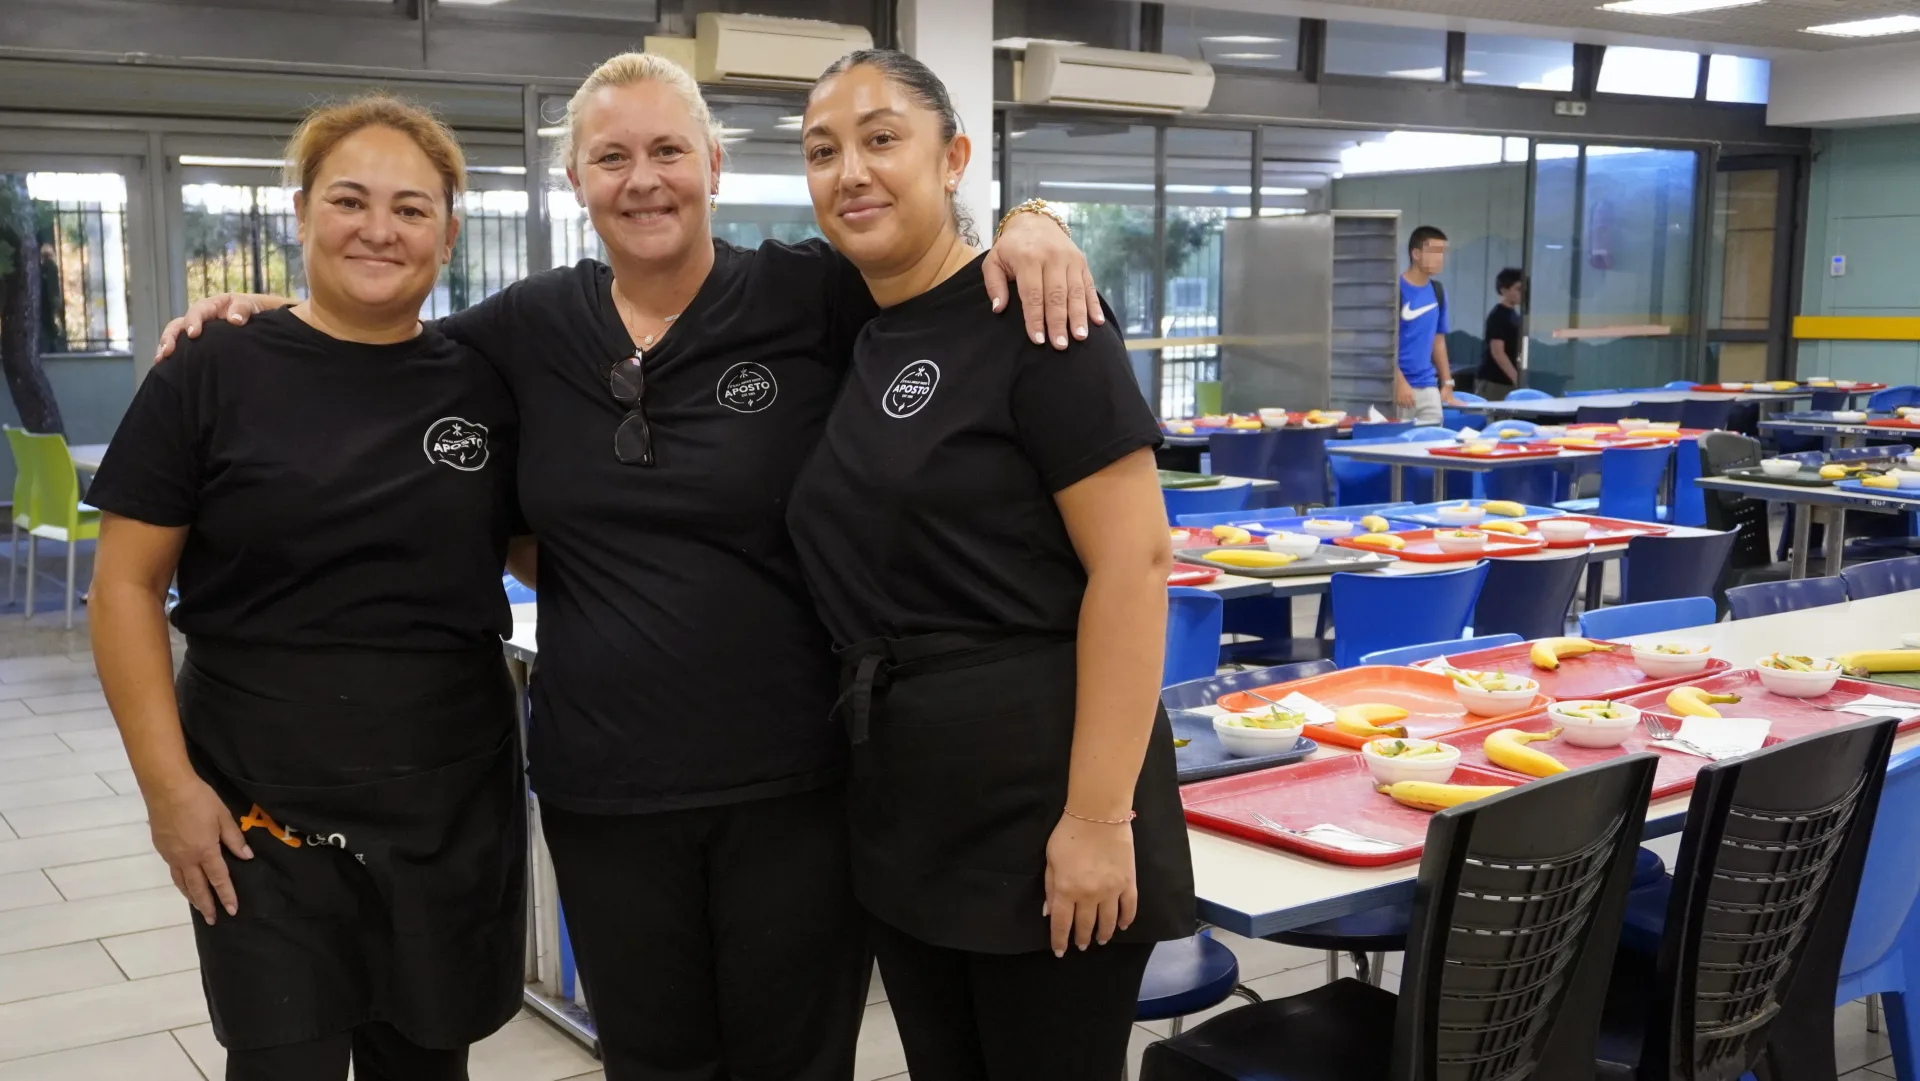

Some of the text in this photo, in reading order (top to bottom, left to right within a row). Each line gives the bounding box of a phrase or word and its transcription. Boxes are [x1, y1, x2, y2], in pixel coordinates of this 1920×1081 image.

[724, 381, 770, 398] APOSTO
[892, 384, 930, 395] APOSTO
[433, 437, 483, 453] APOSTO
